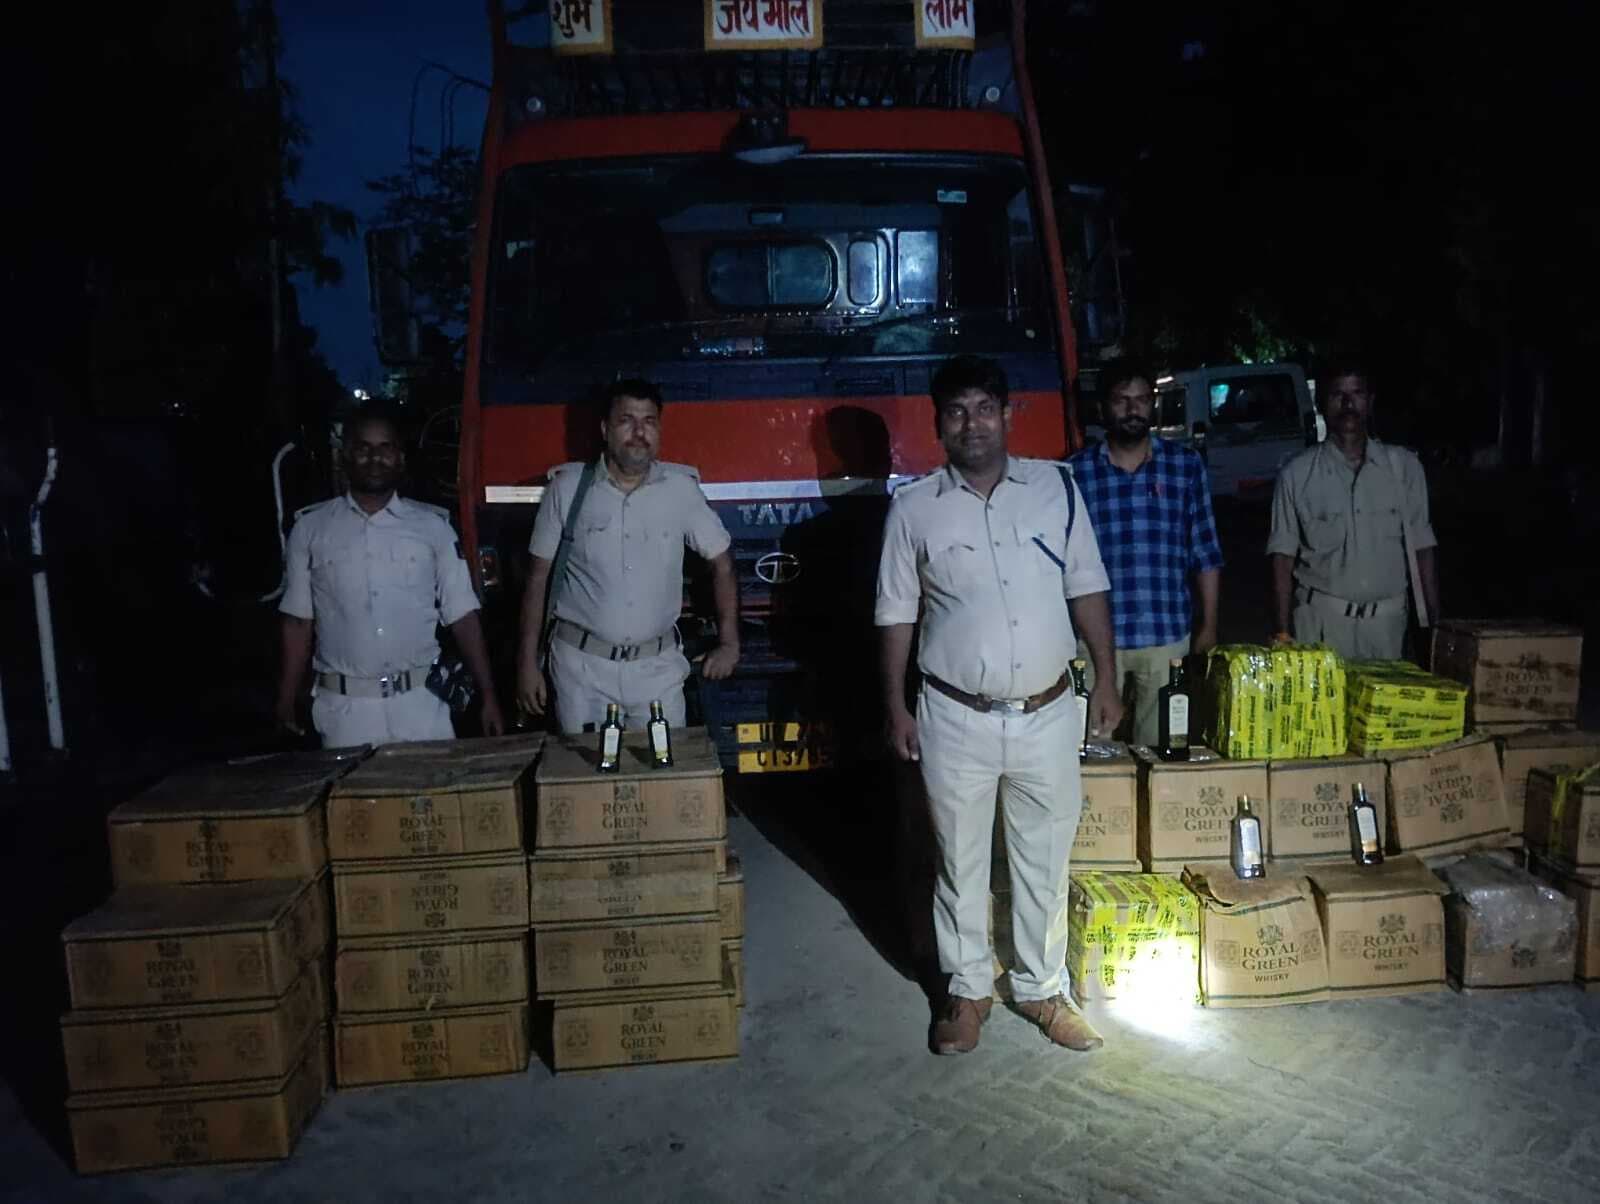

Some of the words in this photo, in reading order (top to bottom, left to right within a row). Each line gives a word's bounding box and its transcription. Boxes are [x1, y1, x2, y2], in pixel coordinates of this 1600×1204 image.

[738, 503, 815, 525] TATA
[602, 802, 647, 816] ROYAL
[400, 815, 445, 828] ROYAL
[602, 816, 648, 830] GREEN
[400, 829, 446, 843] GREEN
[1363, 933, 1416, 947] ROYAL
[603, 946, 648, 959] ROYAL
[1242, 943, 1298, 957] ROYAL
[1363, 946, 1419, 960] GREEN
[603, 960, 648, 974] GREEN
[1242, 955, 1299, 970] GREEN
[408, 968, 451, 981] ROYAL
[1254, 973, 1290, 983] WHISKY
[408, 982, 453, 995] GREEN
[621, 1023, 665, 1037] ROYAL
[620, 1036, 667, 1050] GREEN
